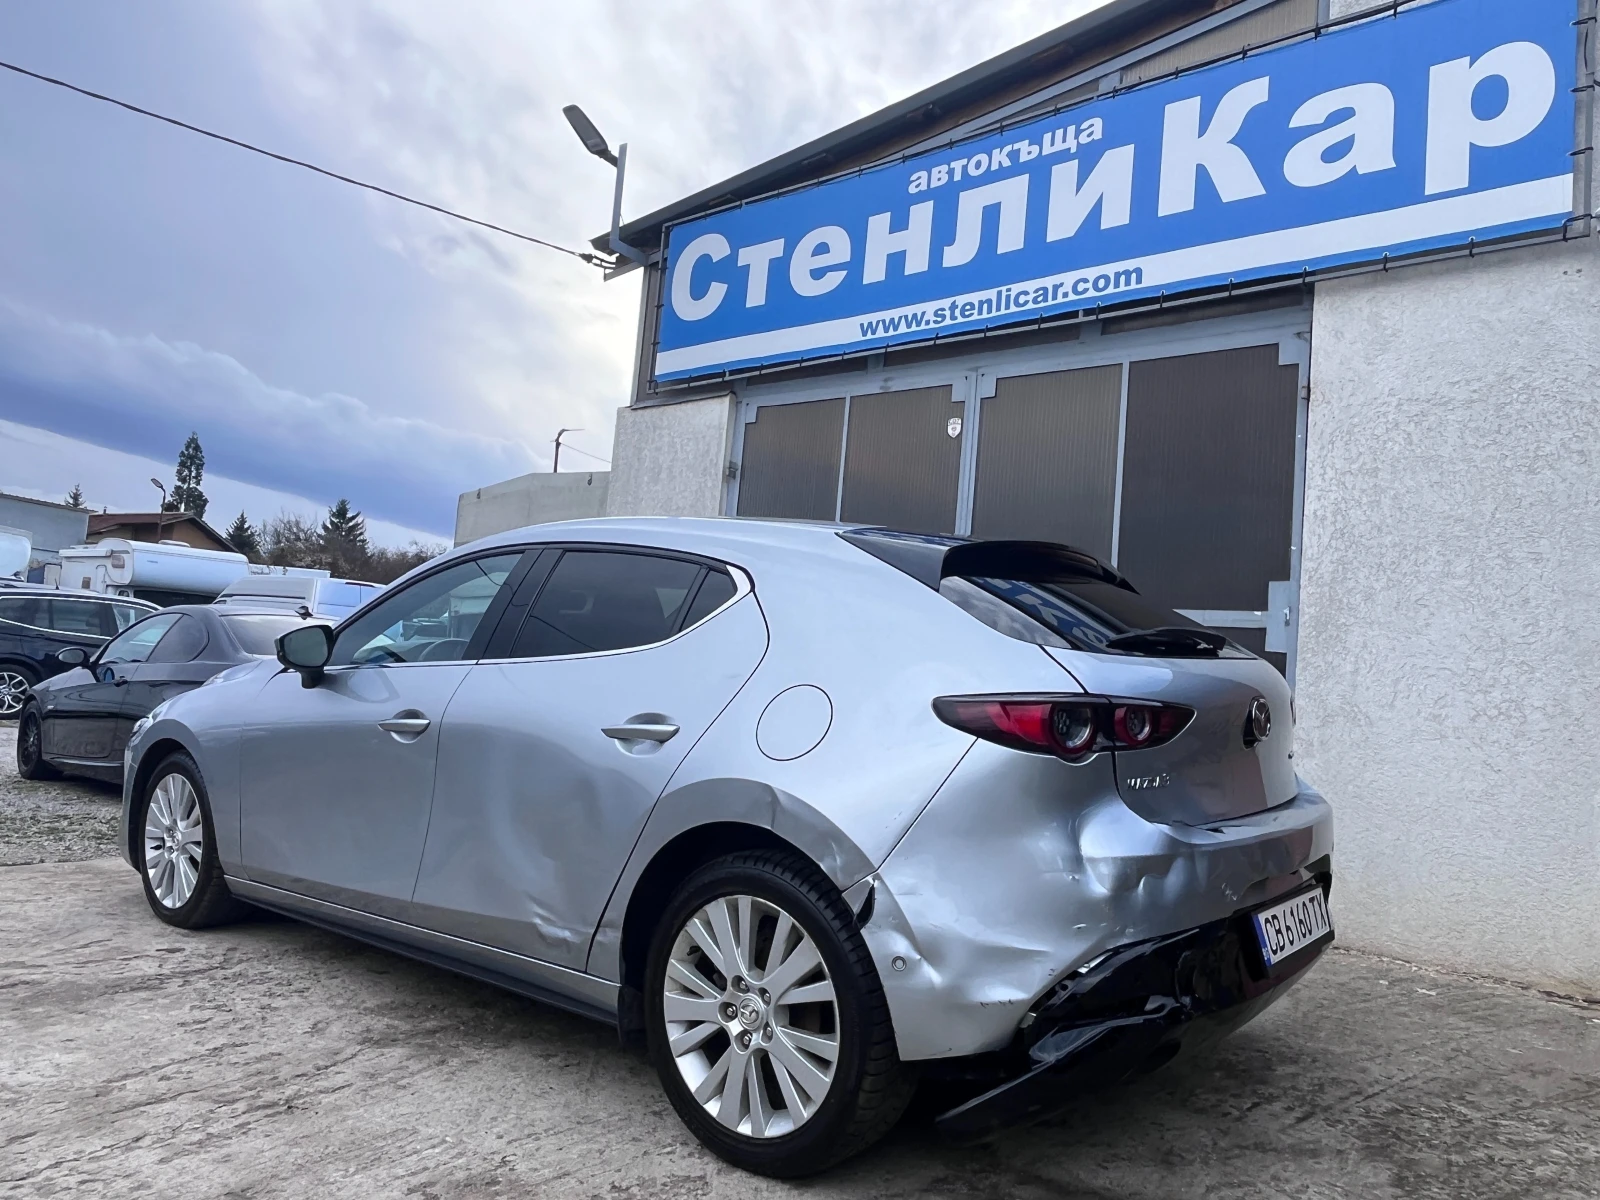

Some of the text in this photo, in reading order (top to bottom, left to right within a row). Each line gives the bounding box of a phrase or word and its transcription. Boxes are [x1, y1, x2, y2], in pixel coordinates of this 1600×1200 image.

[671, 41, 1556, 322] СтенлиКар
[908, 117, 1103, 194] автокъща
[860, 264, 1143, 337] www.stenlicar.com
